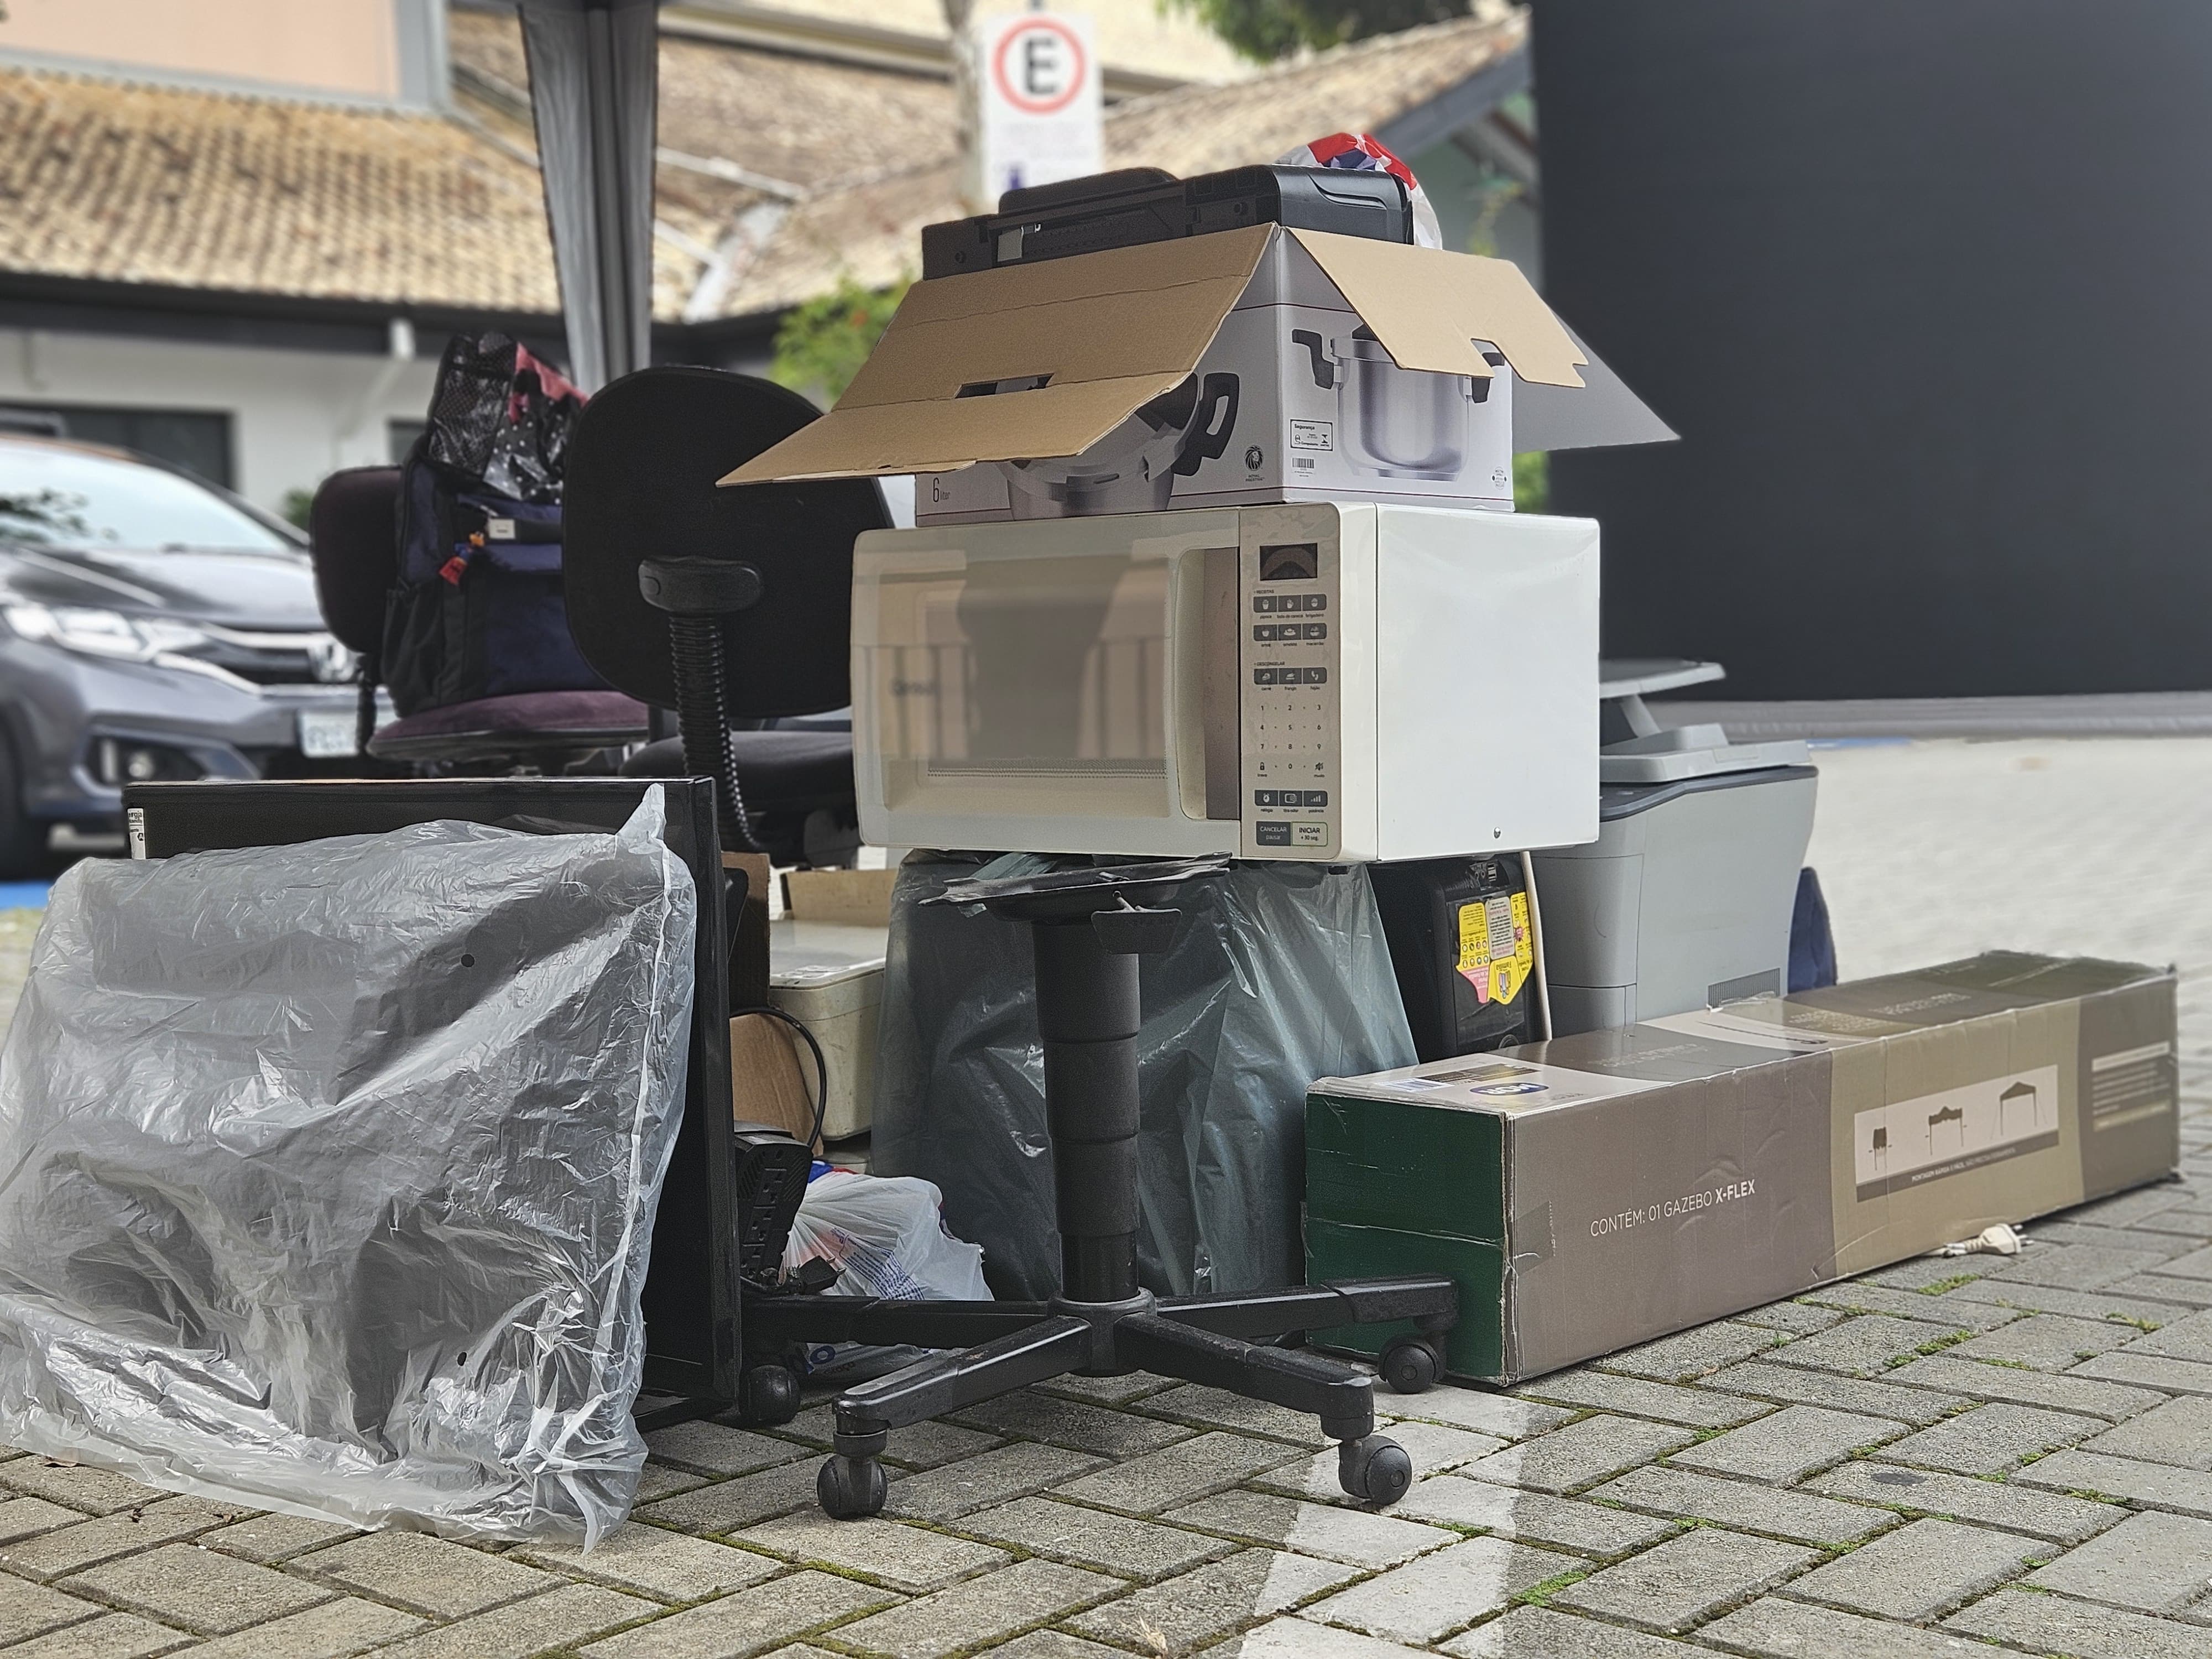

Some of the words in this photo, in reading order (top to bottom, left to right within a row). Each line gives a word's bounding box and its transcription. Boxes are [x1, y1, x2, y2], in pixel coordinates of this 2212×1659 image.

[1025, 38, 1057, 95] E
[933, 477, 939, 502] 6
[1478, 1084, 1540, 1095] MOR
[1590, 1207, 1646, 1237] CONTÉM:
[1648, 1204, 1661, 1222] 01
[1663, 1191, 1713, 1218] GAZEBO
[1715, 1179, 1756, 1204] X-FLEX
